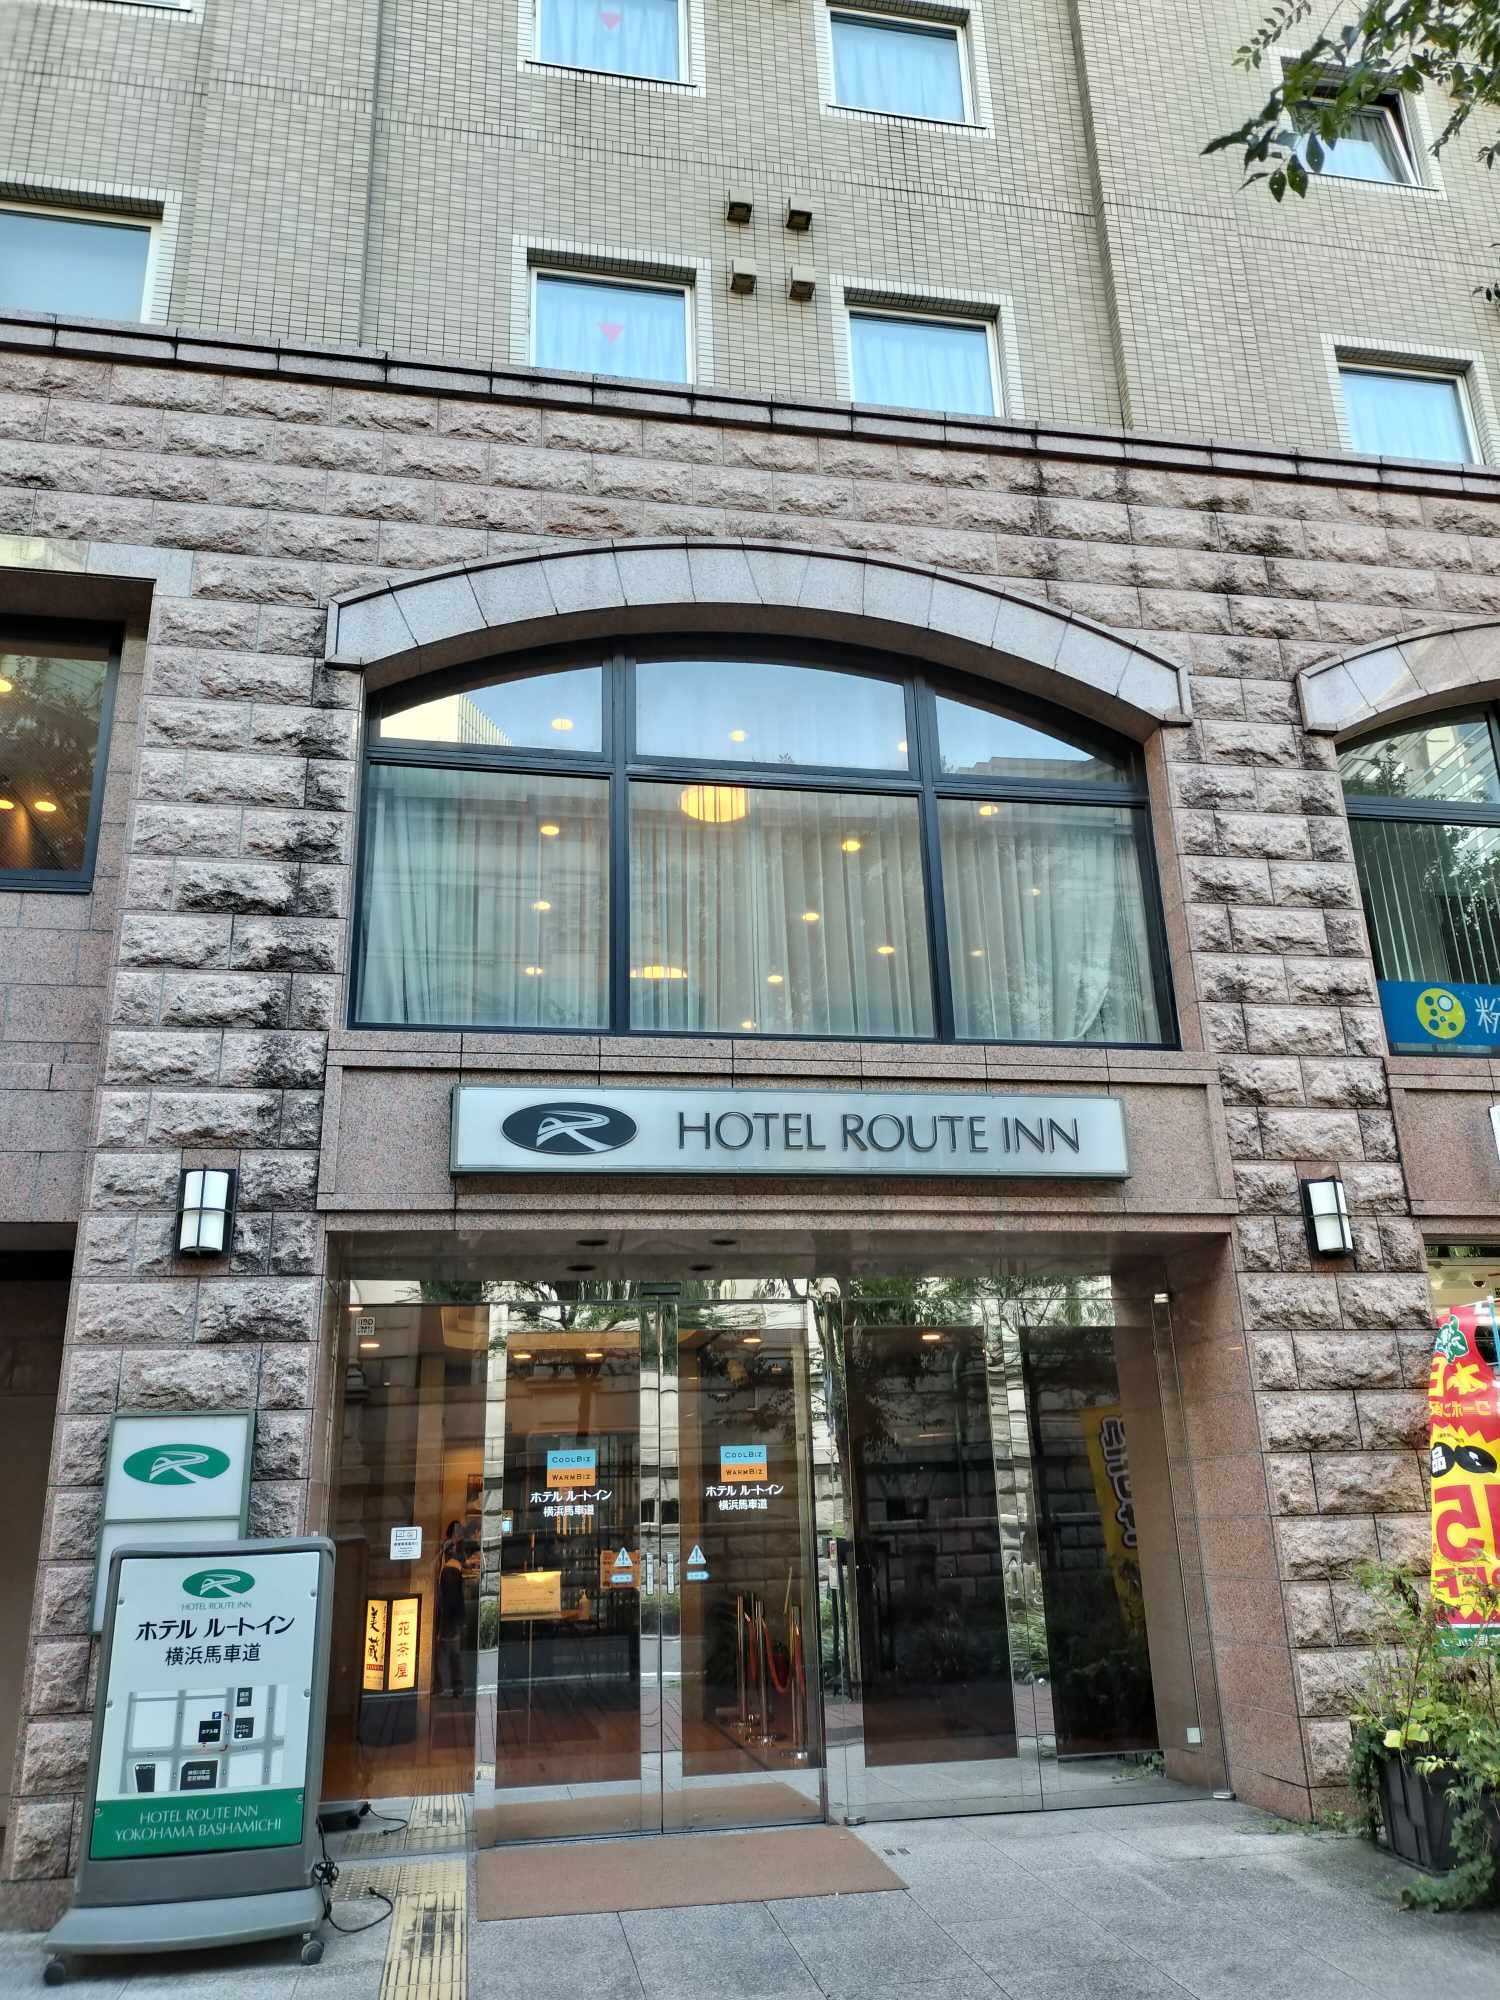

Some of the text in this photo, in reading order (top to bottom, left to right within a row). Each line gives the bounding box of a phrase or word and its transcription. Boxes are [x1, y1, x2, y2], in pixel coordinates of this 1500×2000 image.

[678, 1111, 1080, 1154] HOTEL ROUTE INN
[530, 1489, 612, 1503] ホテル ルートイン
[705, 1484, 784, 1497] ホテル ルートイン
[543, 1504, 595, 1517] 横浜馬車道
[718, 1499, 768, 1511] 横浜馬車道
[182, 1601, 252, 1611] HOTEL ROUTE INN
[135, 1615, 295, 1641] ホテル ルートイン
[165, 1643, 262, 1667] 横浜馬車道
[140, 1804, 259, 1824] HOTEL ROUTE INN
[115, 1818, 282, 1842] YOKOHAMA BASHAMICHI
